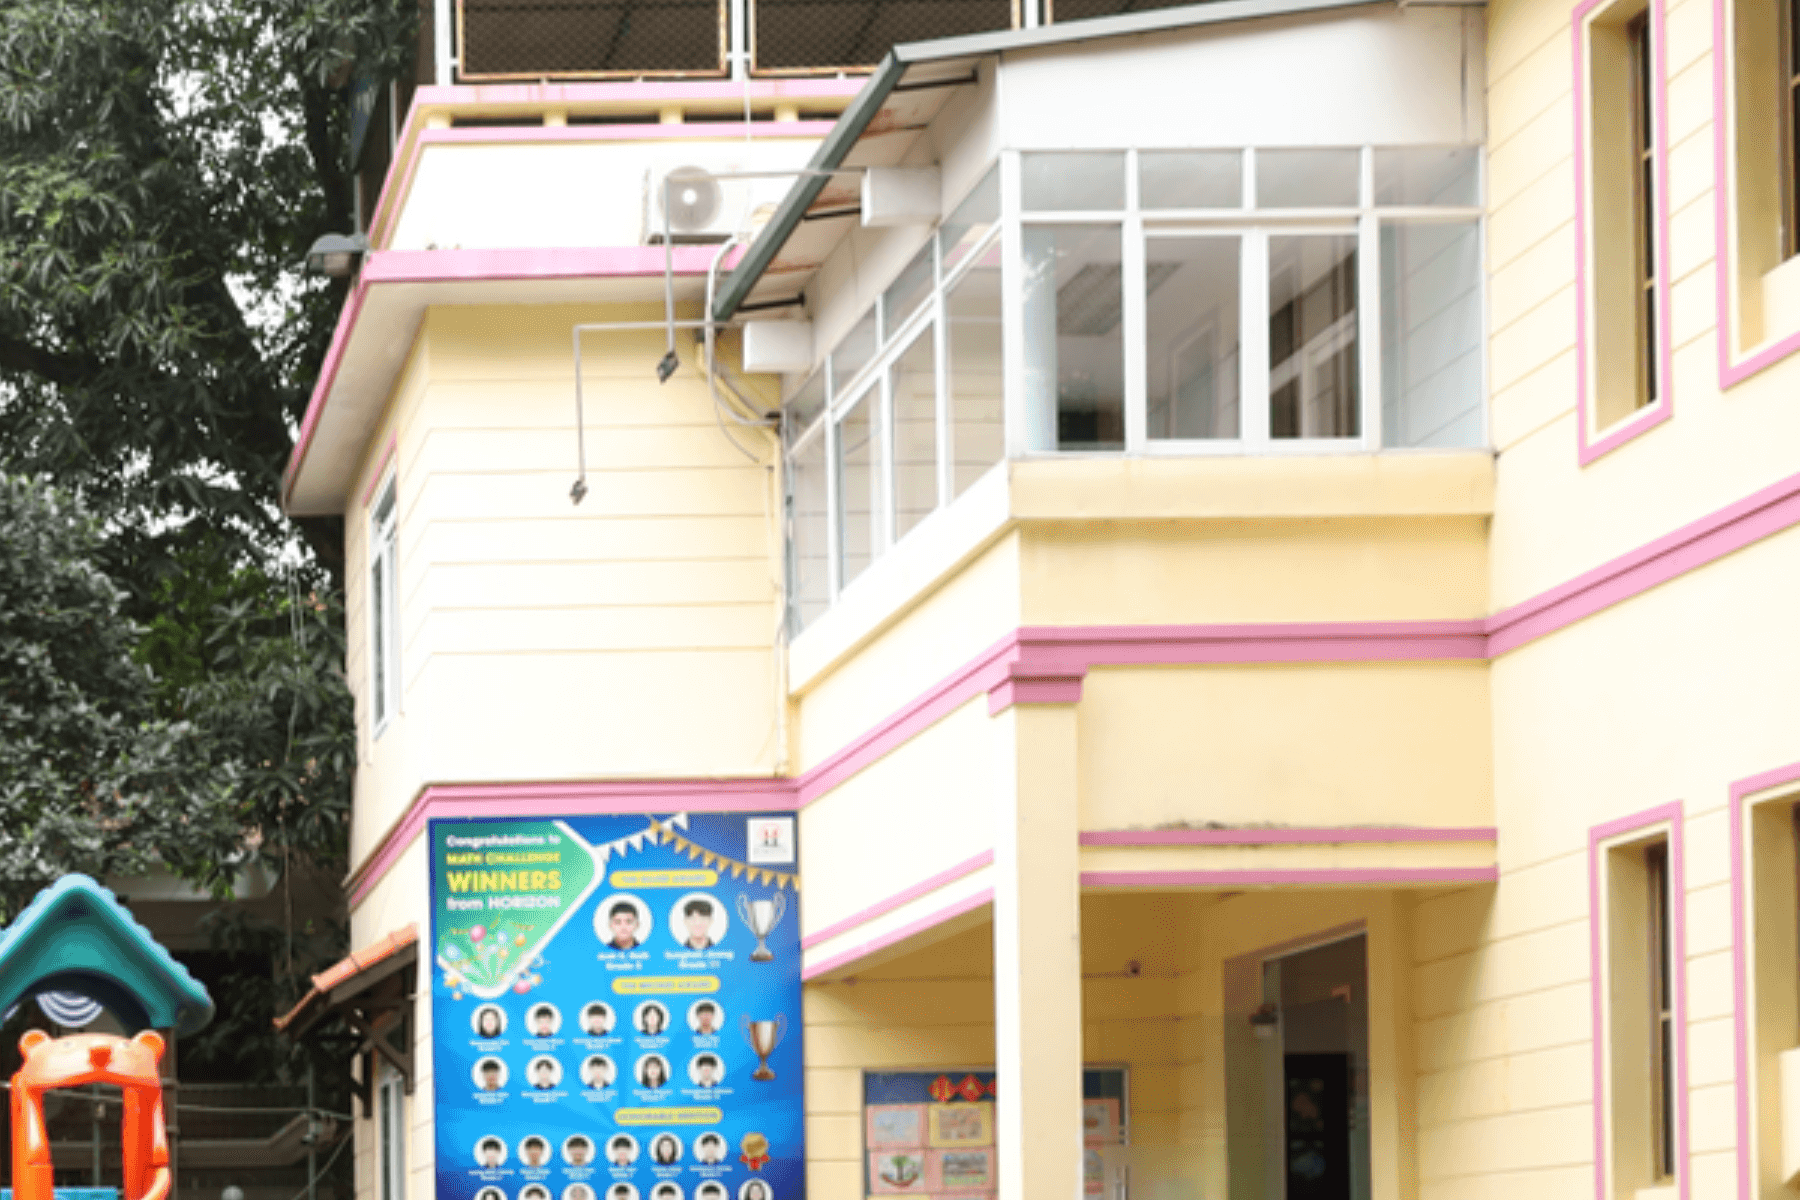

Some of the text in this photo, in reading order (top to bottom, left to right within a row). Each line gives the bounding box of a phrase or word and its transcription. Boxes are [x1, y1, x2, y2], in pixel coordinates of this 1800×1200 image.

[446, 870, 562, 893] WINNERS
[447, 895, 561, 910] from HORIZON
